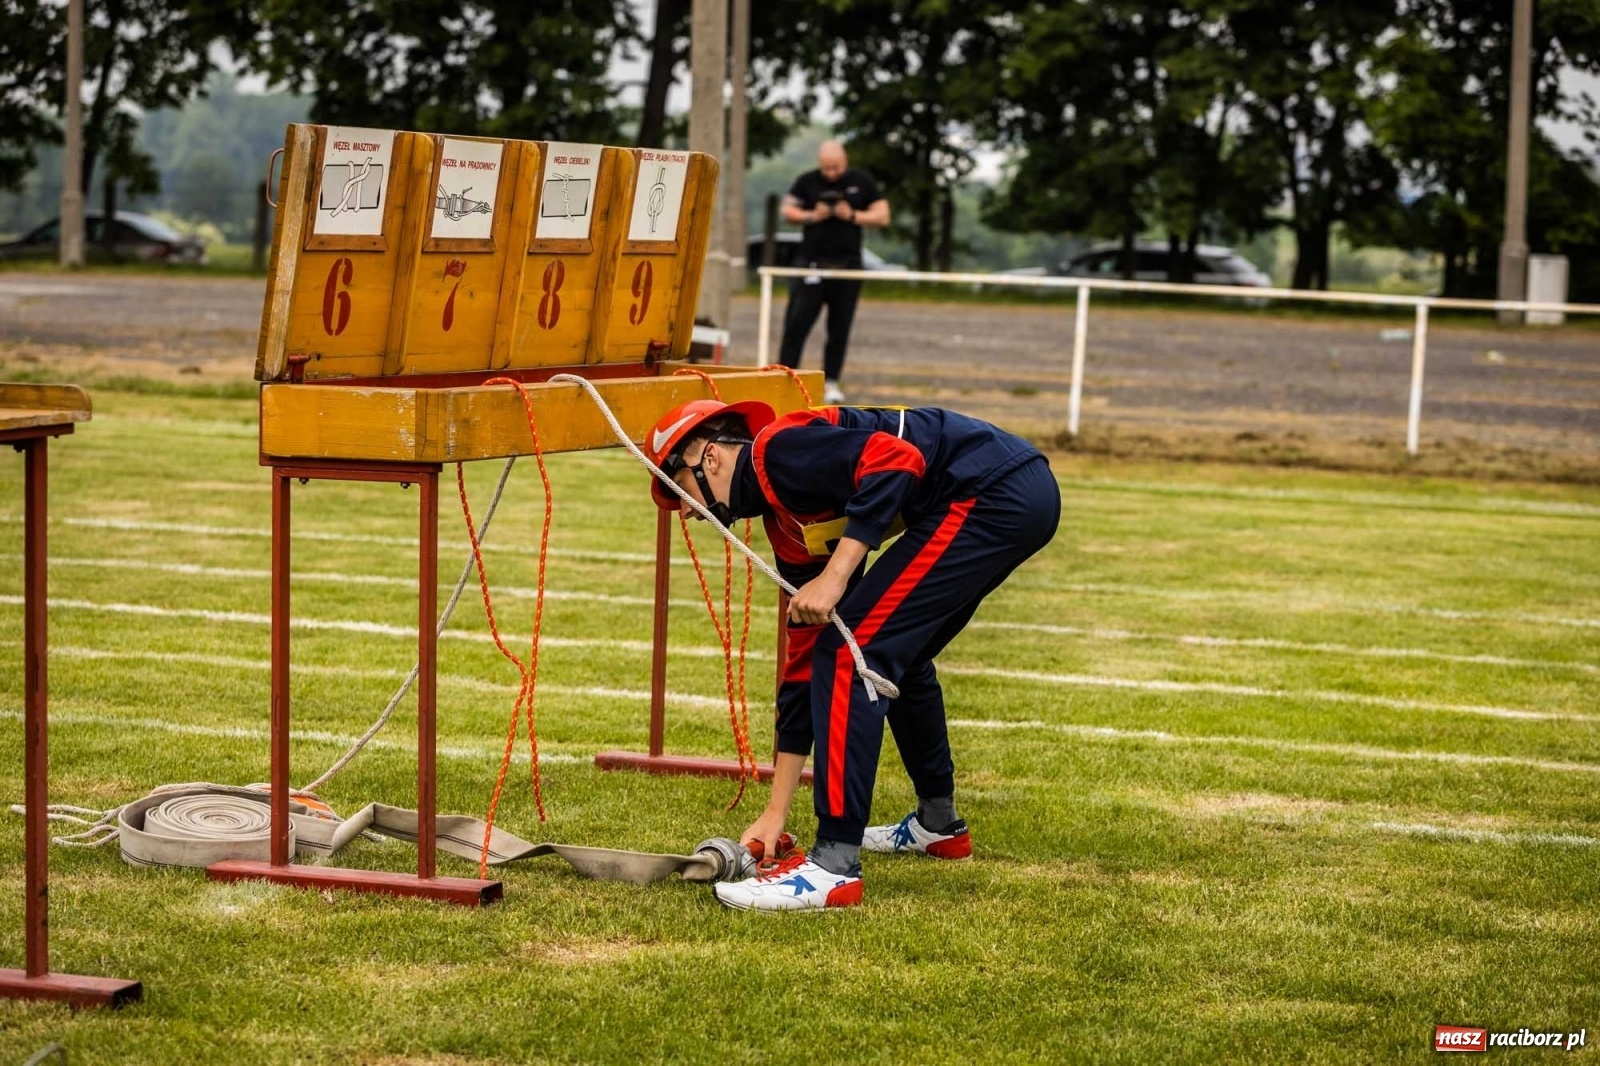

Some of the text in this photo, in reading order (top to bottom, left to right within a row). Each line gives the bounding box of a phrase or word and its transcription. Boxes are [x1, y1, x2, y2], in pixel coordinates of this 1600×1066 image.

[353, 142, 380, 152] MASZTOWY
[459, 160, 467, 168] NA
[322, 257, 353, 337] 6
[442, 259, 467, 332] 7
[537, 259, 566, 330] 8
[629, 259, 654, 327] 9
